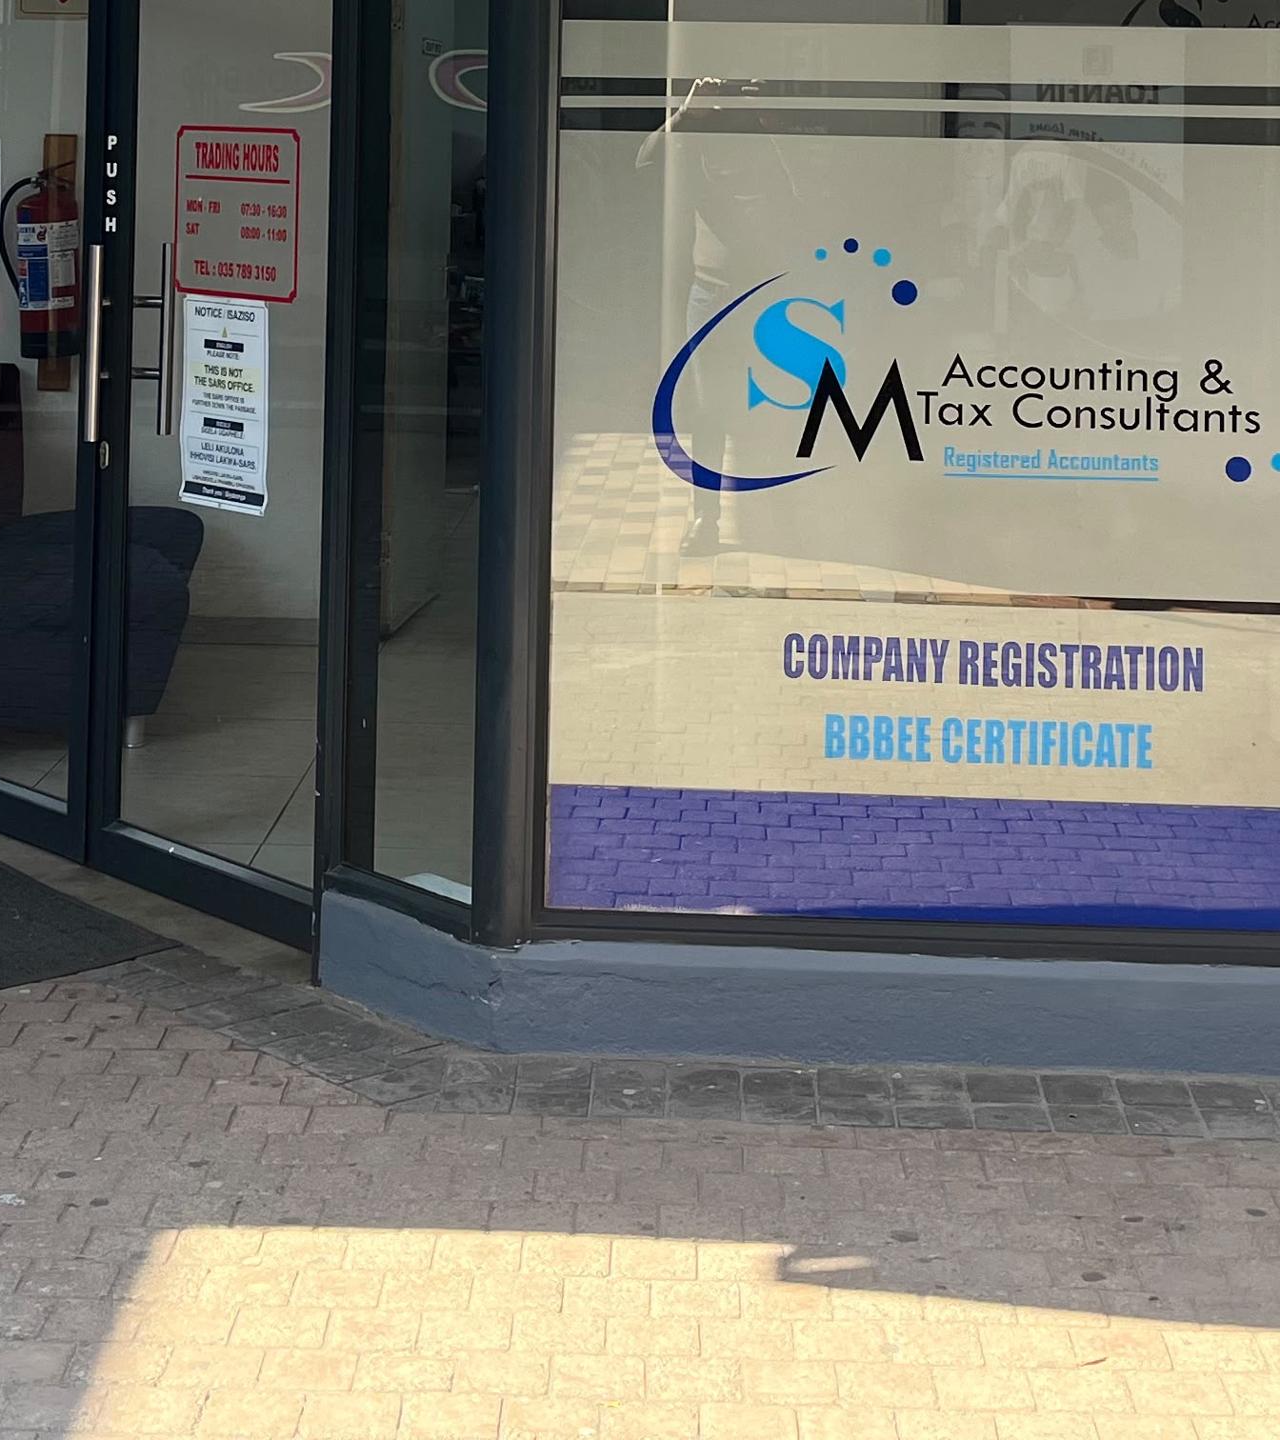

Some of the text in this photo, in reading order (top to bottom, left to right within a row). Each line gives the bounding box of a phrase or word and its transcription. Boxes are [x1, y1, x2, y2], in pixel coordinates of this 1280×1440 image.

[195, 141, 280, 172] TRADING HOURS
[186, 199, 203, 213] MON
[208, 201, 221, 213] FRI
[185, 222, 200, 235] SAT
[194, 260, 210, 276] TEL
[217, 262, 234, 277] 035
[255, 265, 277, 282] 3150
[194, 306, 223, 319] NOTICE
[194, 375, 208, 387] THE
[204, 364, 244, 378] THIS IS NOT
[942, 353, 1234, 403] Accounting &
[916, 390, 1262, 434] Tax Consultants
[943, 446, 1159, 474] Registered Accountants
[782, 632, 1205, 693] COMPANY REGISTRATION
[824, 713, 1153, 770] BBBEE CERTIFICATE
